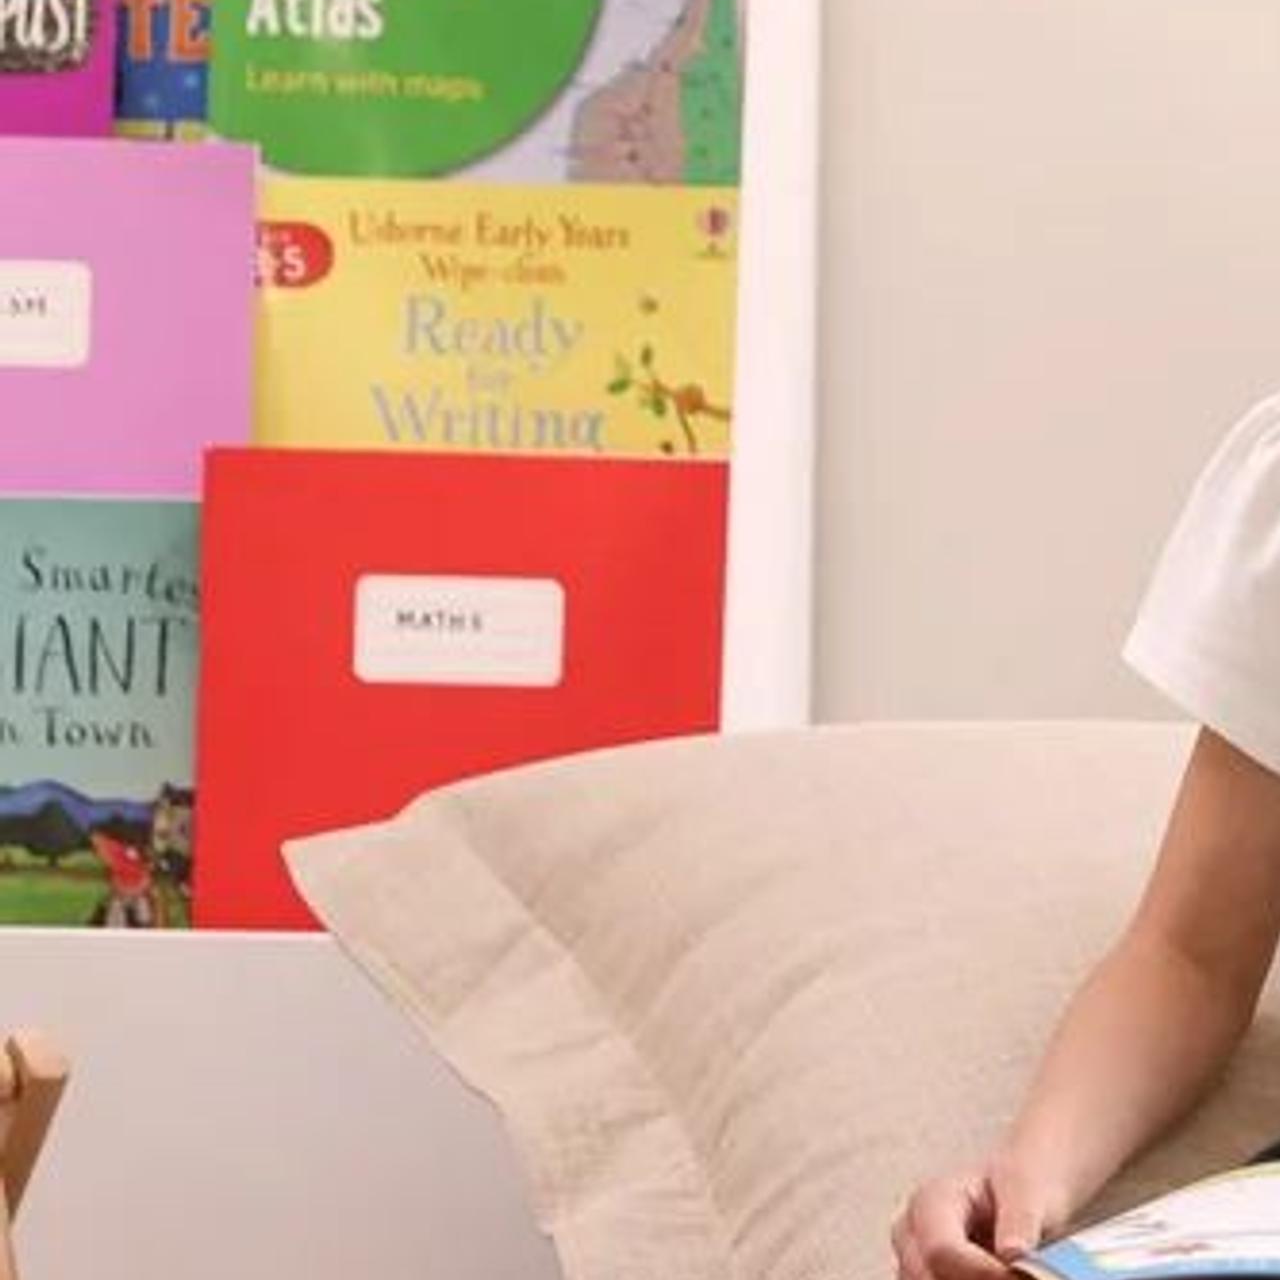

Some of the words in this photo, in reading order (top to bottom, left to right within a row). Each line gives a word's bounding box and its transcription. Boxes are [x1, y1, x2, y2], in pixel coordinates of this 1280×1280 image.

[245, 63, 328, 93] Learn
[335, 69, 398, 96] with
[404, 76, 484, 102] maps
[348, 211, 466, 247] Usborne
[474, 214, 551, 253] Early
[556, 217, 632, 250] Years
[402, 293, 587, 370] Ready
[14, 613, 188, 697] IANT
[33, 705, 154, 750] Town
